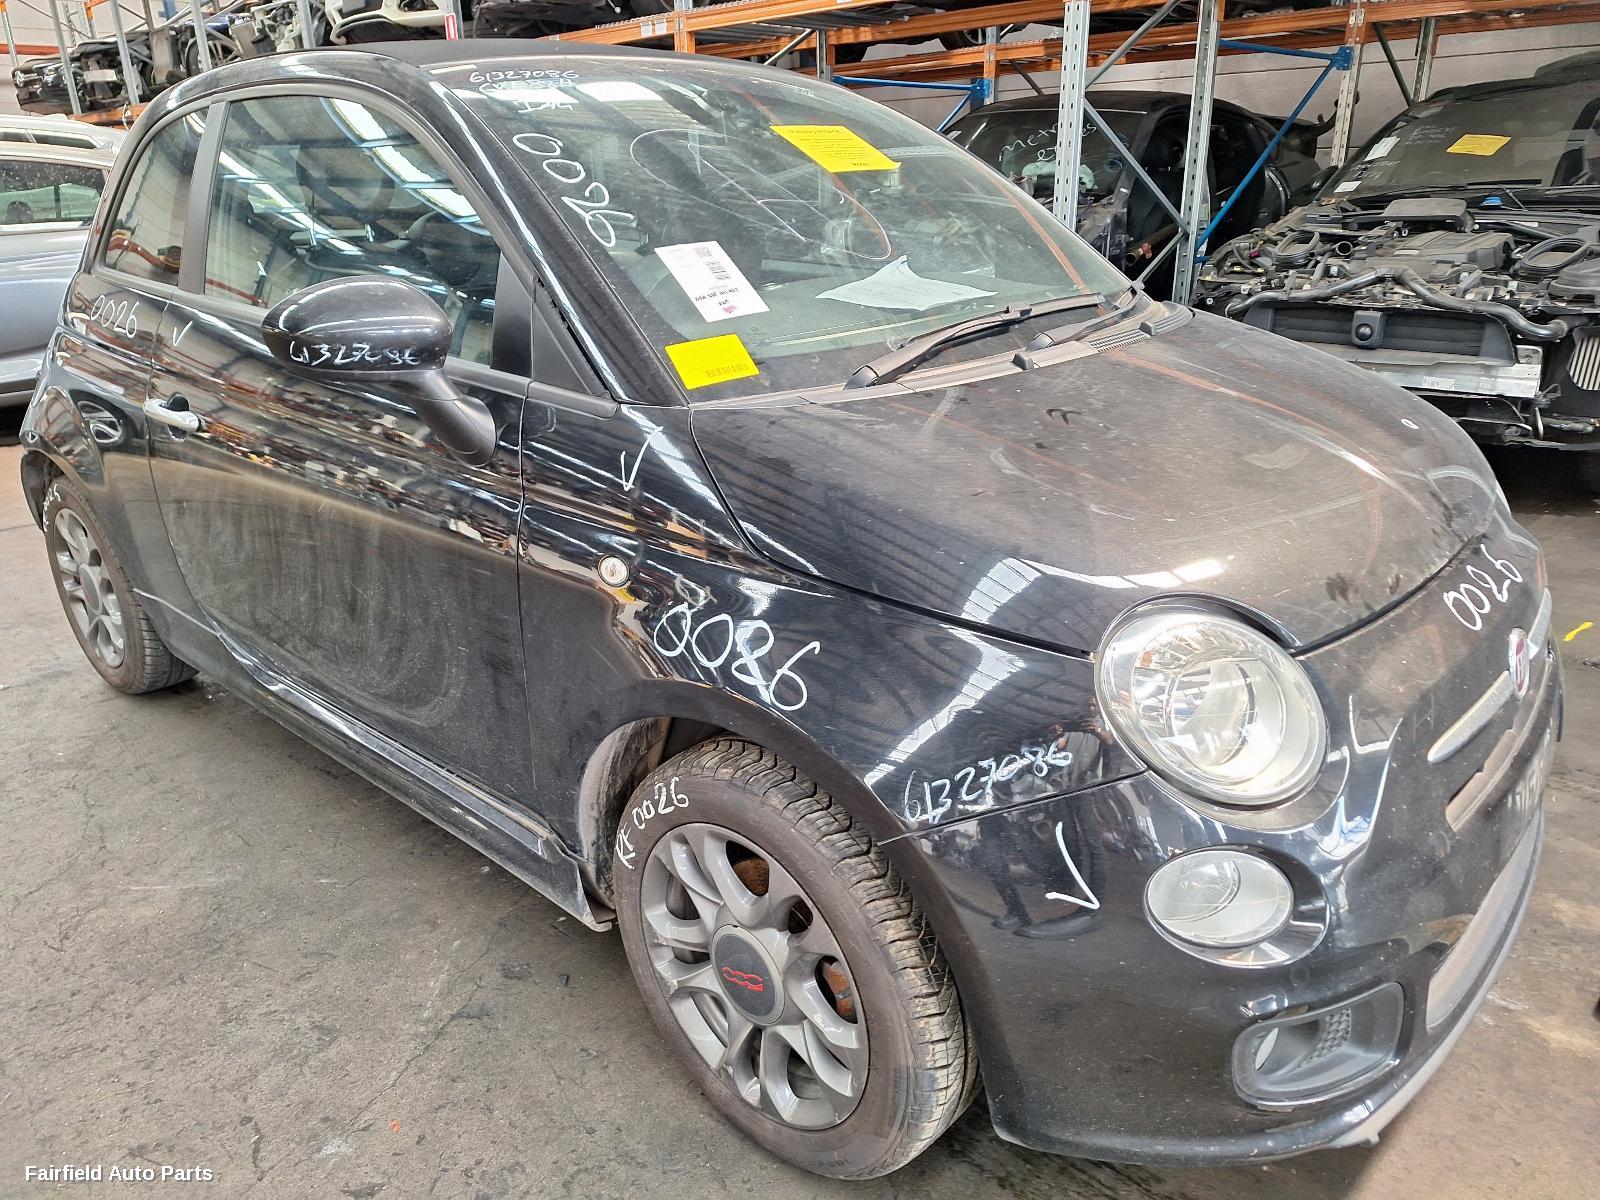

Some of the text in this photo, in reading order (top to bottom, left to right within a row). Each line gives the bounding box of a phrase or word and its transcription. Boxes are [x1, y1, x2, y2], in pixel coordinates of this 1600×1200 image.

[469, 70, 580, 83] 61327086
[512, 132, 635, 247] 0026
[90, 295, 140, 339] 0026
[1443, 544, 1524, 631] 0026
[632, 777, 690, 830] 0026
[903, 742, 1073, 825] 61327086
